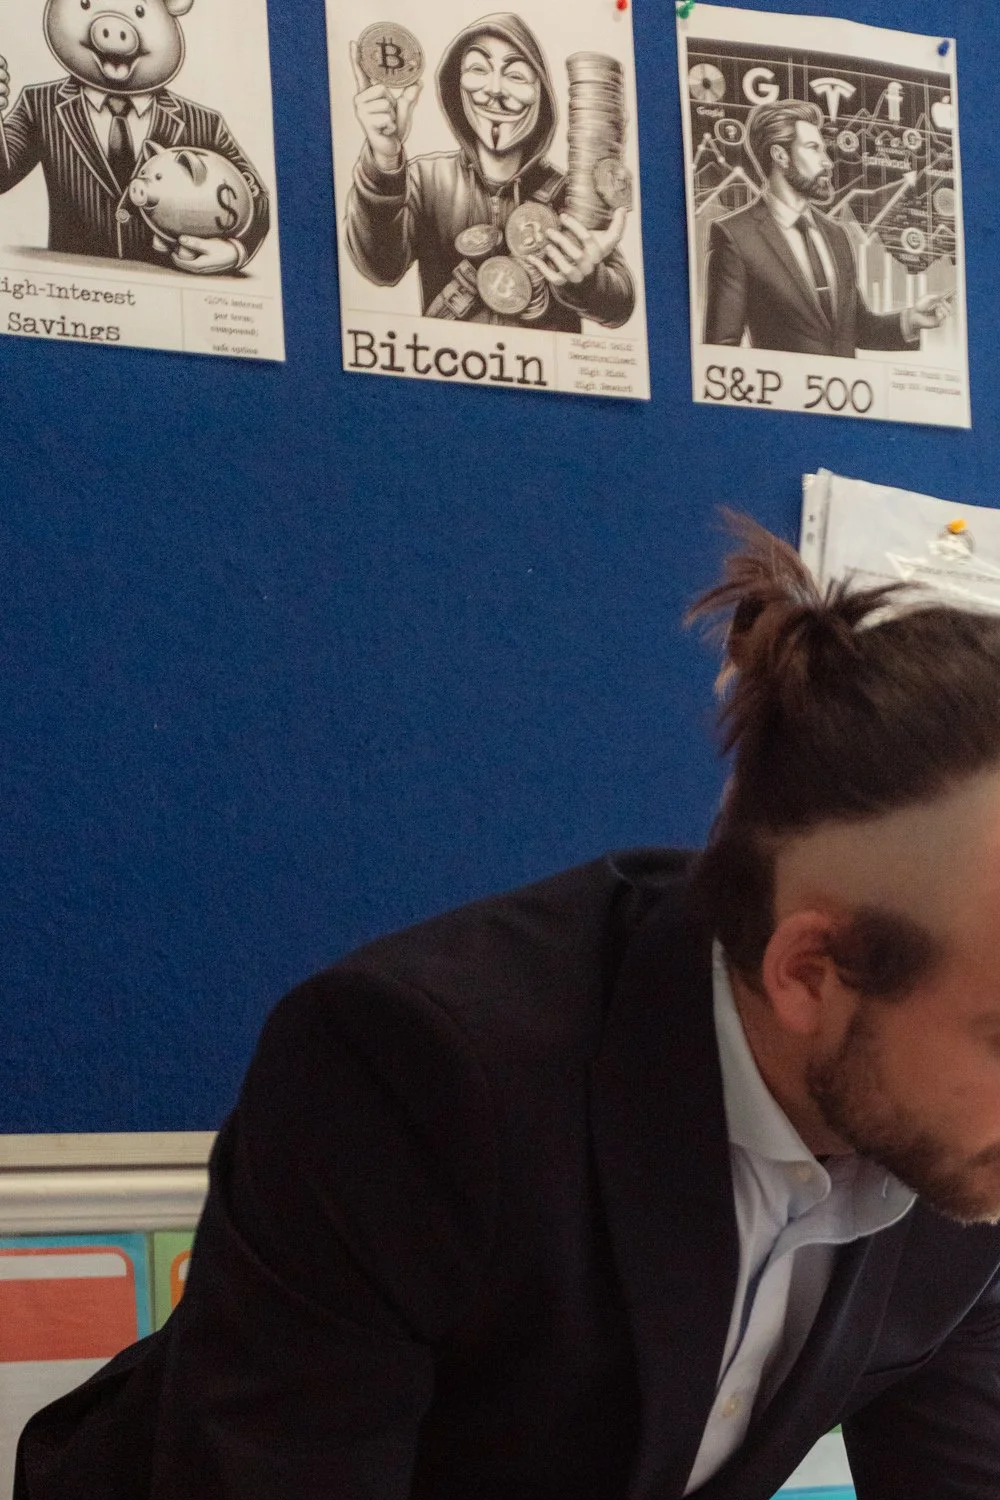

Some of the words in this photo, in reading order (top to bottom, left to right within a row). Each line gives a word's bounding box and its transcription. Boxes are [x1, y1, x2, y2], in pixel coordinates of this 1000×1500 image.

[0, 276, 136, 306] igh-Interest
[7, 311, 121, 341] Savings
[348, 329, 547, 386] Bitcoin
[704, 364, 784, 405] S&P
[803, 374, 873, 413] 500
